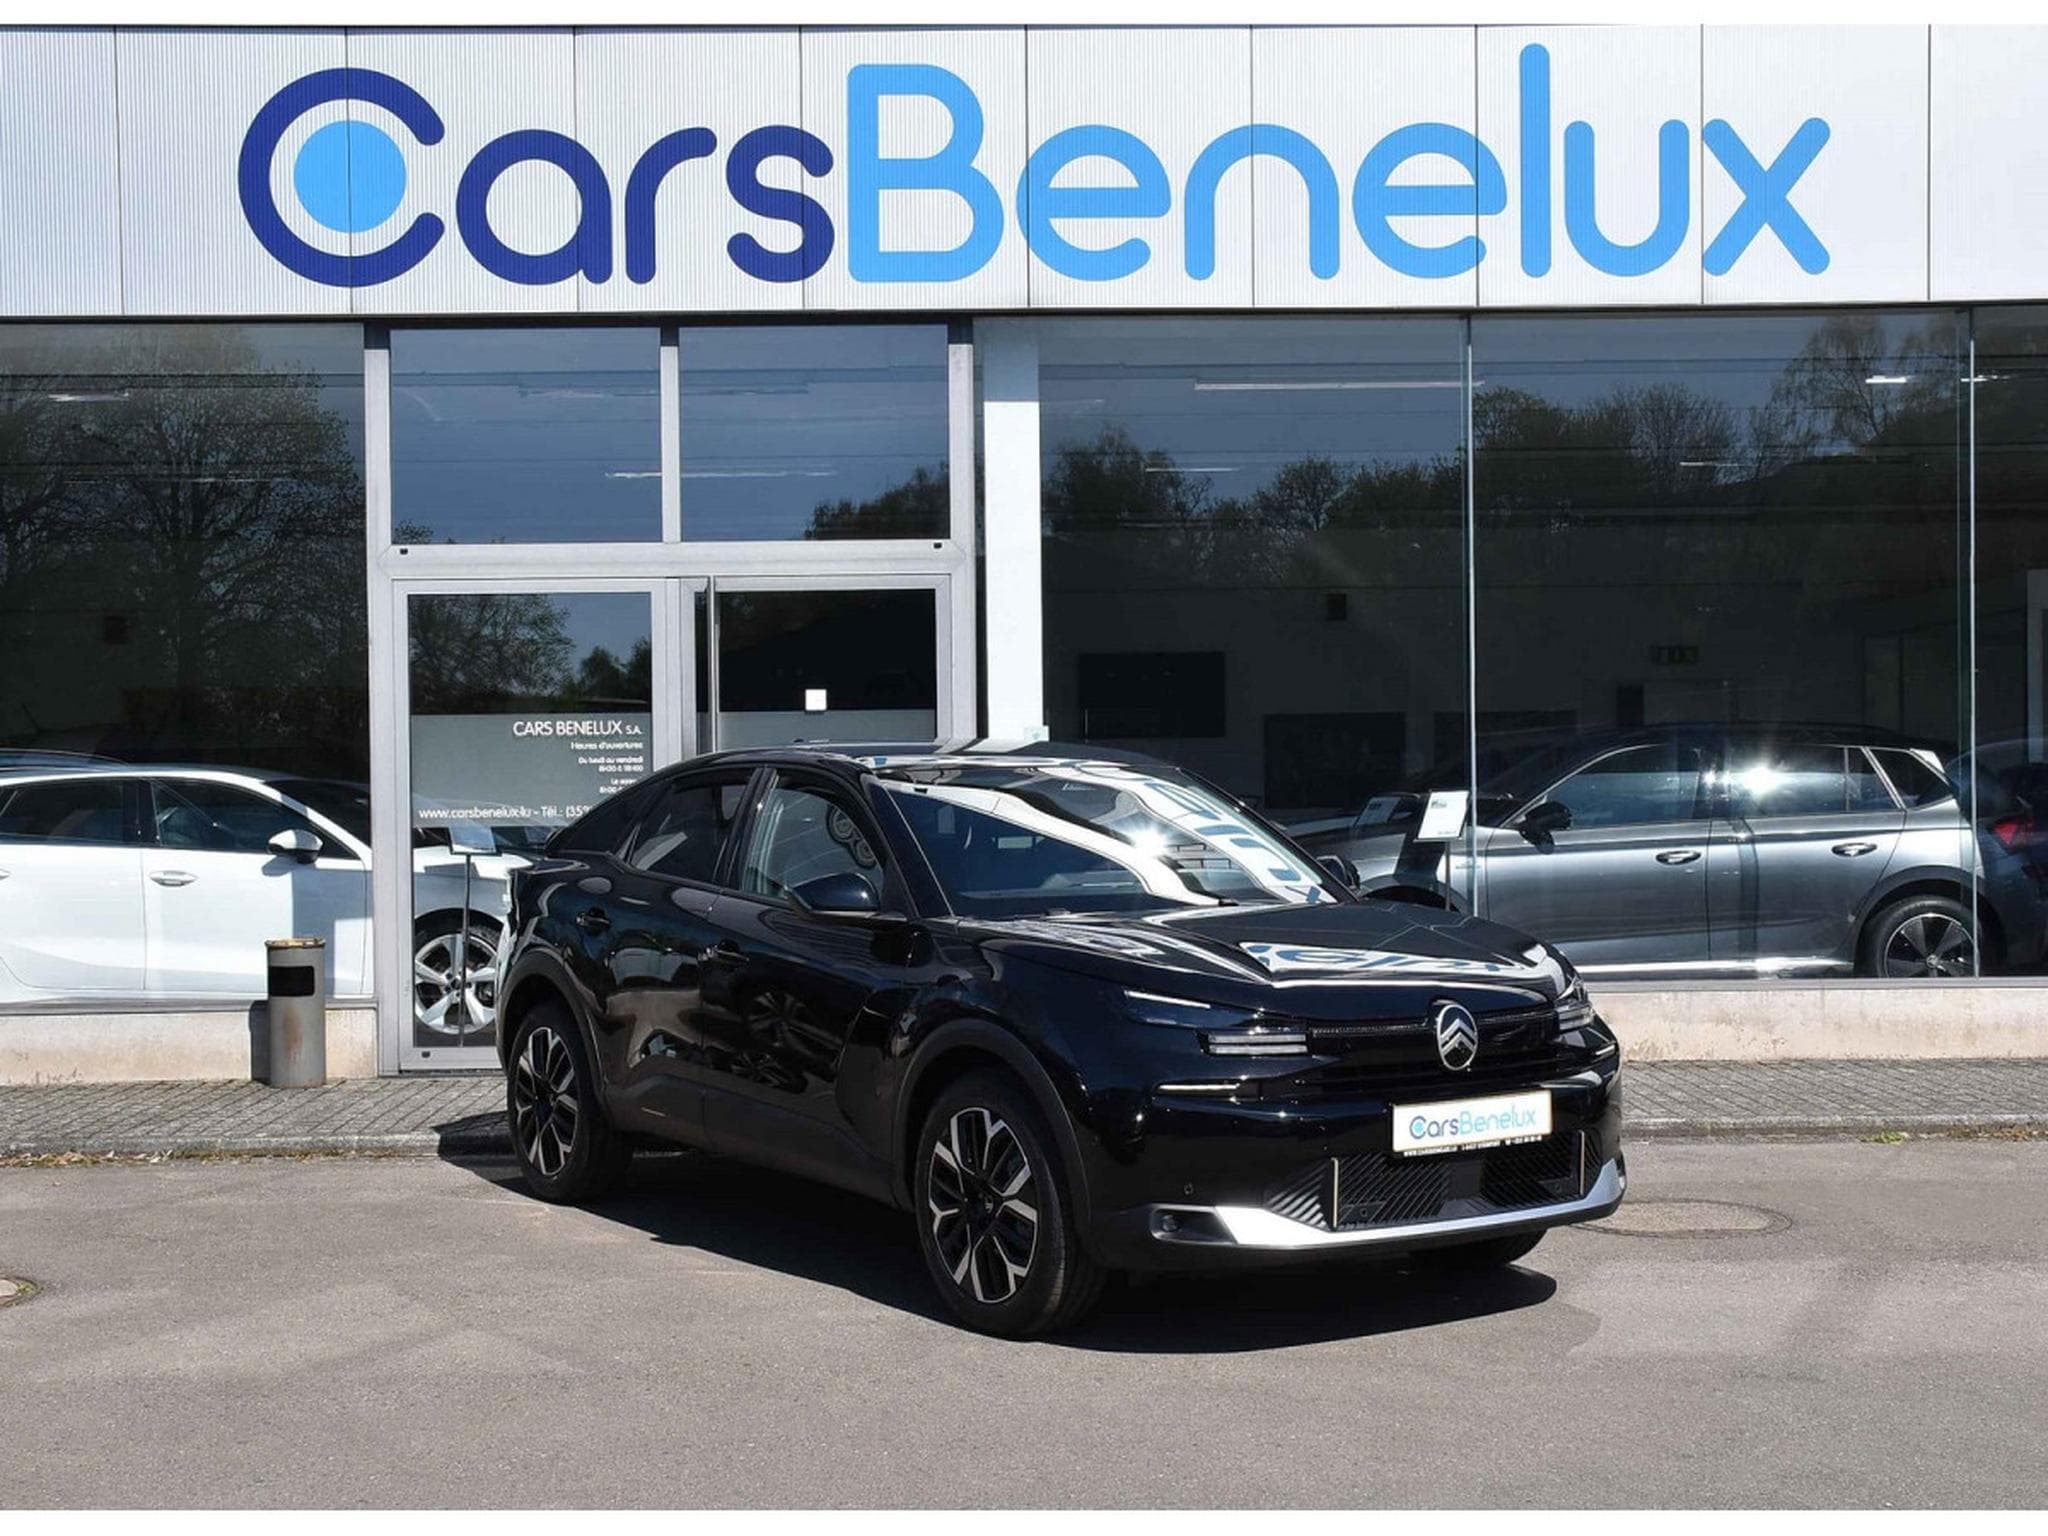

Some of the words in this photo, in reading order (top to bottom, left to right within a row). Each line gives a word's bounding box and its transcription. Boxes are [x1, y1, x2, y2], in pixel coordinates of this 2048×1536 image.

[239, 43, 1831, 287] CarsBenelux
[513, 721, 553, 736] CARS
[556, 720, 622, 736] BENELUX
[571, 742, 598, 750] Heures
[599, 741, 643, 750] d'ouvertures
[419, 806, 531, 818] www.carsbenelux.lu
[1409, 1103, 1536, 1140] CarsBenelux
